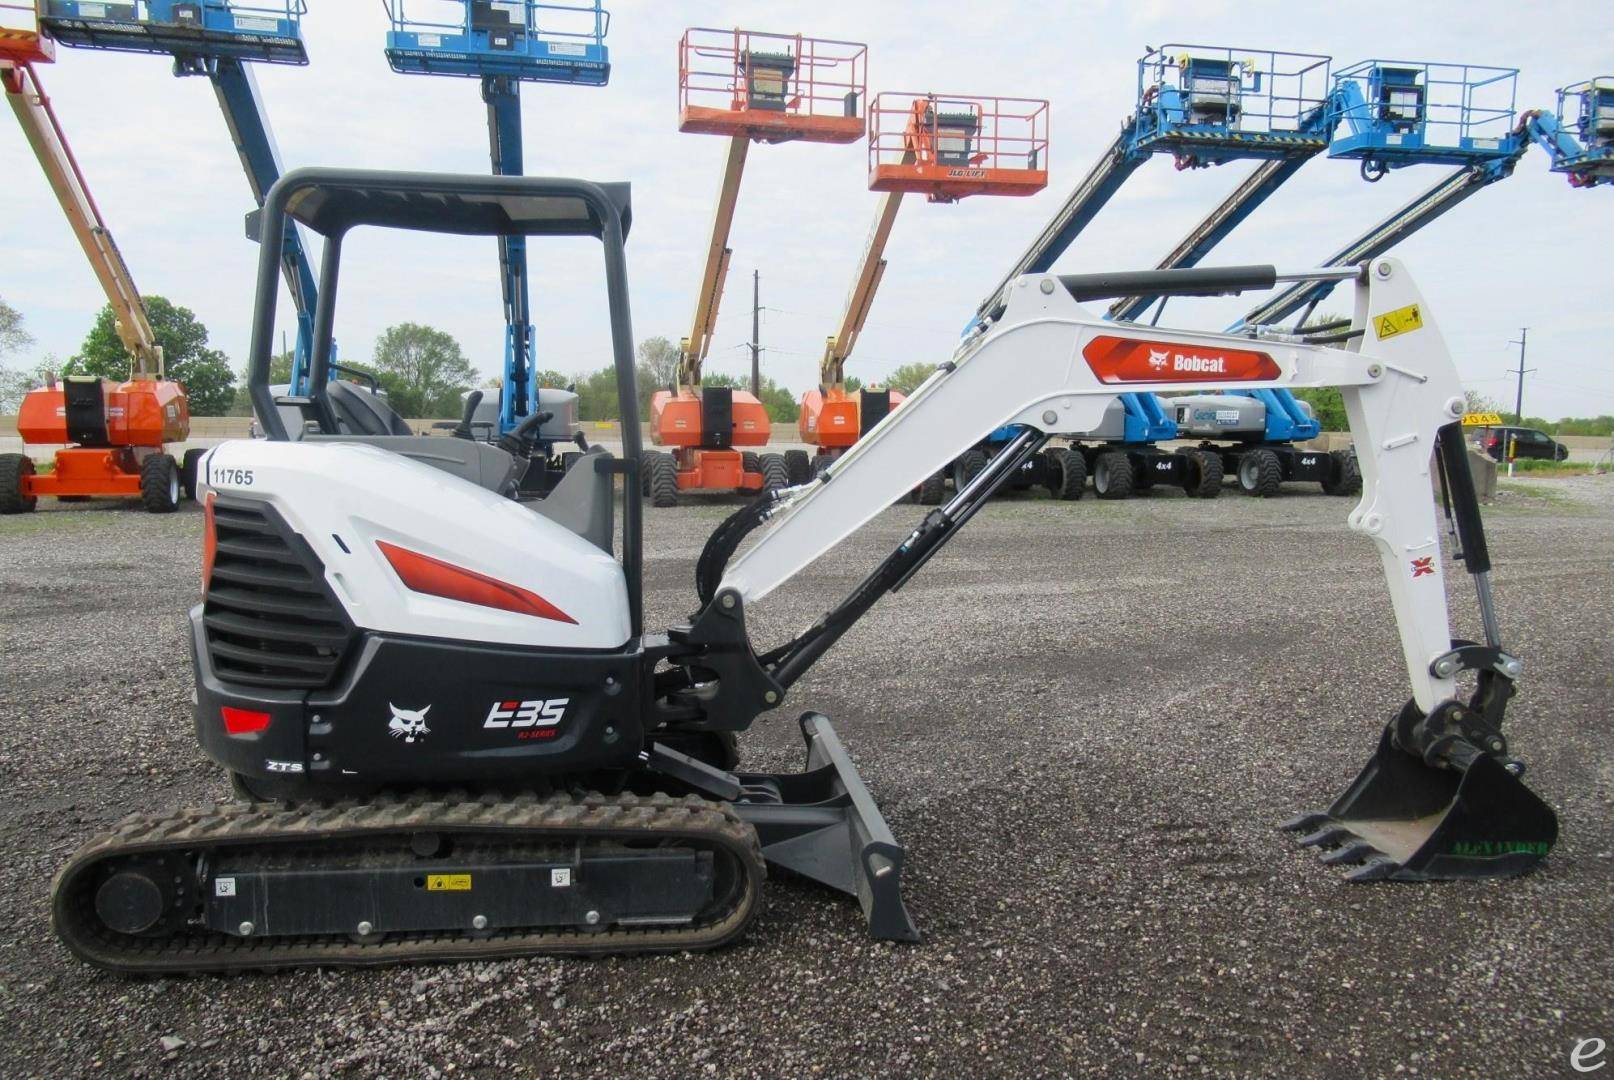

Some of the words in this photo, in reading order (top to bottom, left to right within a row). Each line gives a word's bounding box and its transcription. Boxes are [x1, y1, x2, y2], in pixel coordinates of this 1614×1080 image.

[1174, 354, 1225, 373] Bobcat
[1156, 461, 1172, 471] 4x4
[1301, 457, 1317, 466] 4x4
[214, 468, 254, 486] 11765
[483, 698, 570, 729] E35
[266, 760, 304, 772] ZTS
